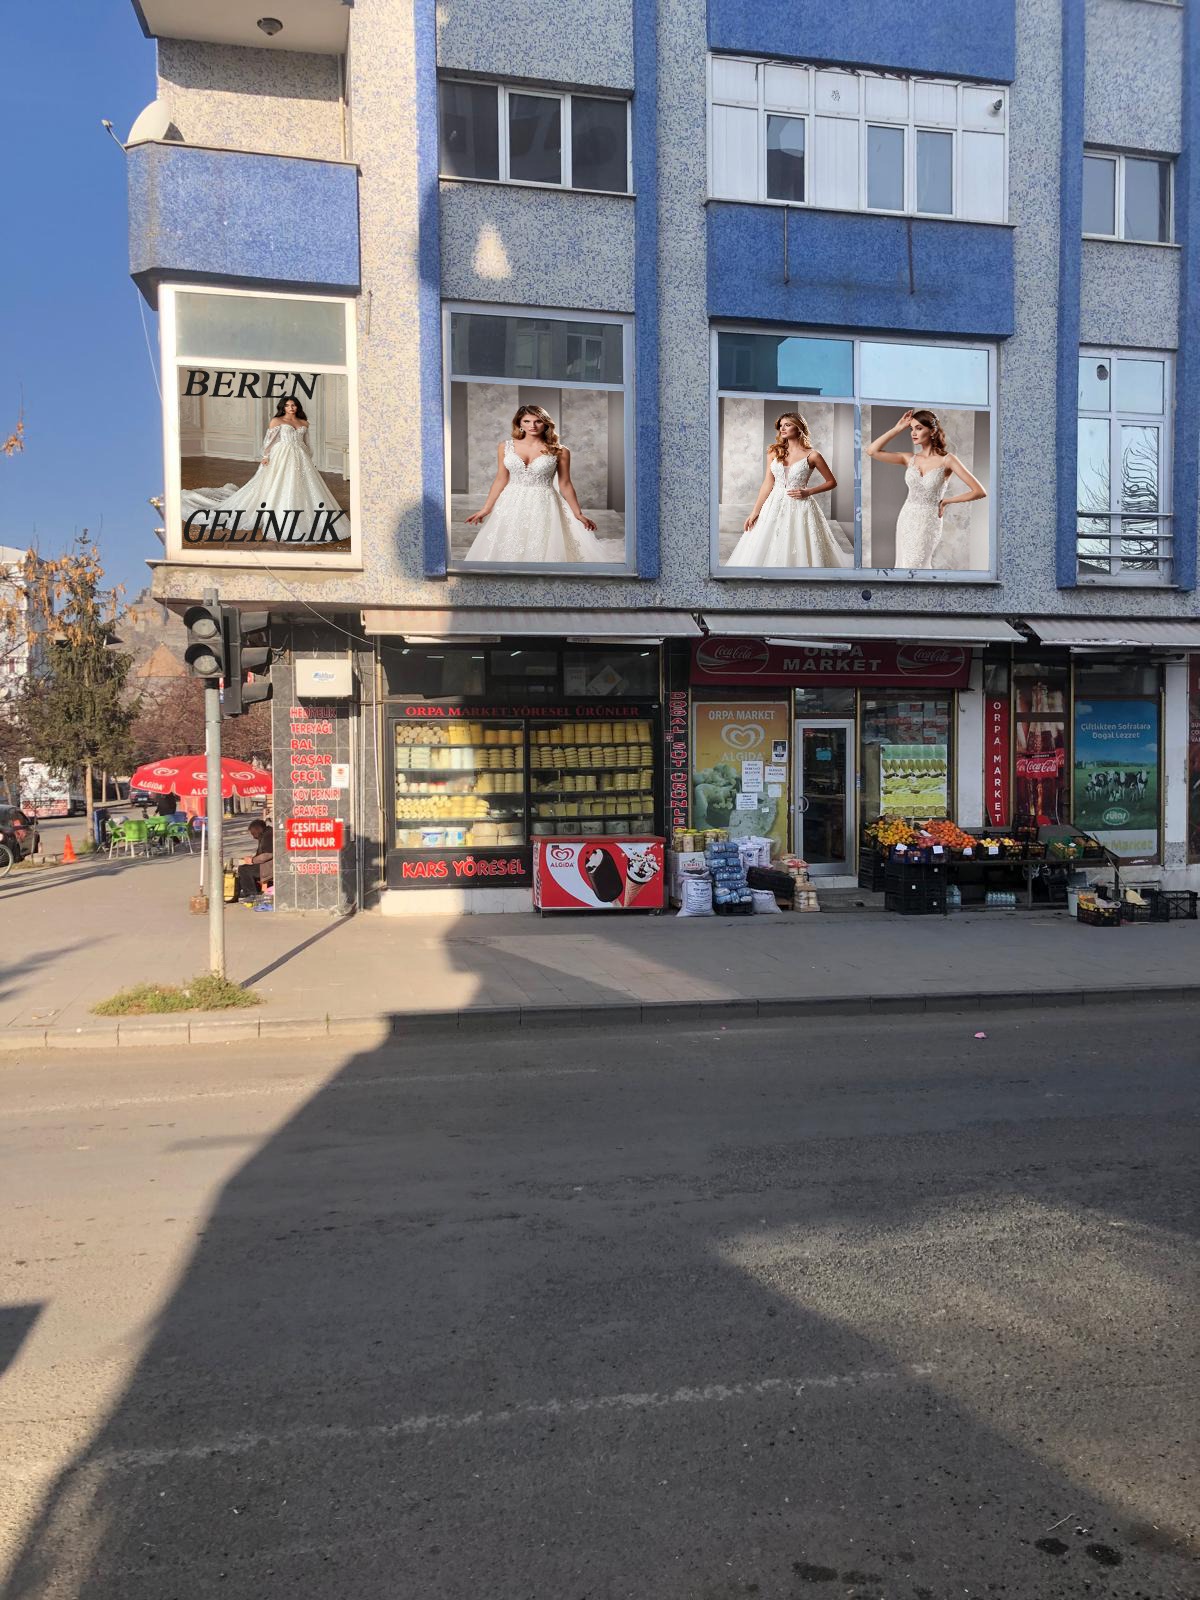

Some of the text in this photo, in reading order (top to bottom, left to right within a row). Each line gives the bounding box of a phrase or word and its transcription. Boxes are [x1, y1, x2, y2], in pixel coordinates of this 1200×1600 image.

[182, 370, 321, 399] BEREN
[184, 502, 348, 543] GELİNLİK
[714, 645, 751, 659] Coca-Cola
[783, 659, 881, 671] MARKET
[405, 704, 639, 717] ORPA MARKET YÖRESEL ÜRÜNLER
[709, 710, 776, 720] ORPA MARKET
[291, 739, 314, 750] BAL
[291, 754, 333, 768] KAŞAR
[994, 702, 1002, 822] ORPA MARKET
[1026, 759, 1058, 773] Coca-Cola
[290, 767, 326, 784] ÇEÇİL
[290, 837, 336, 848] BULUNUR
[402, 856, 526, 878] KARS YÖRESEL
